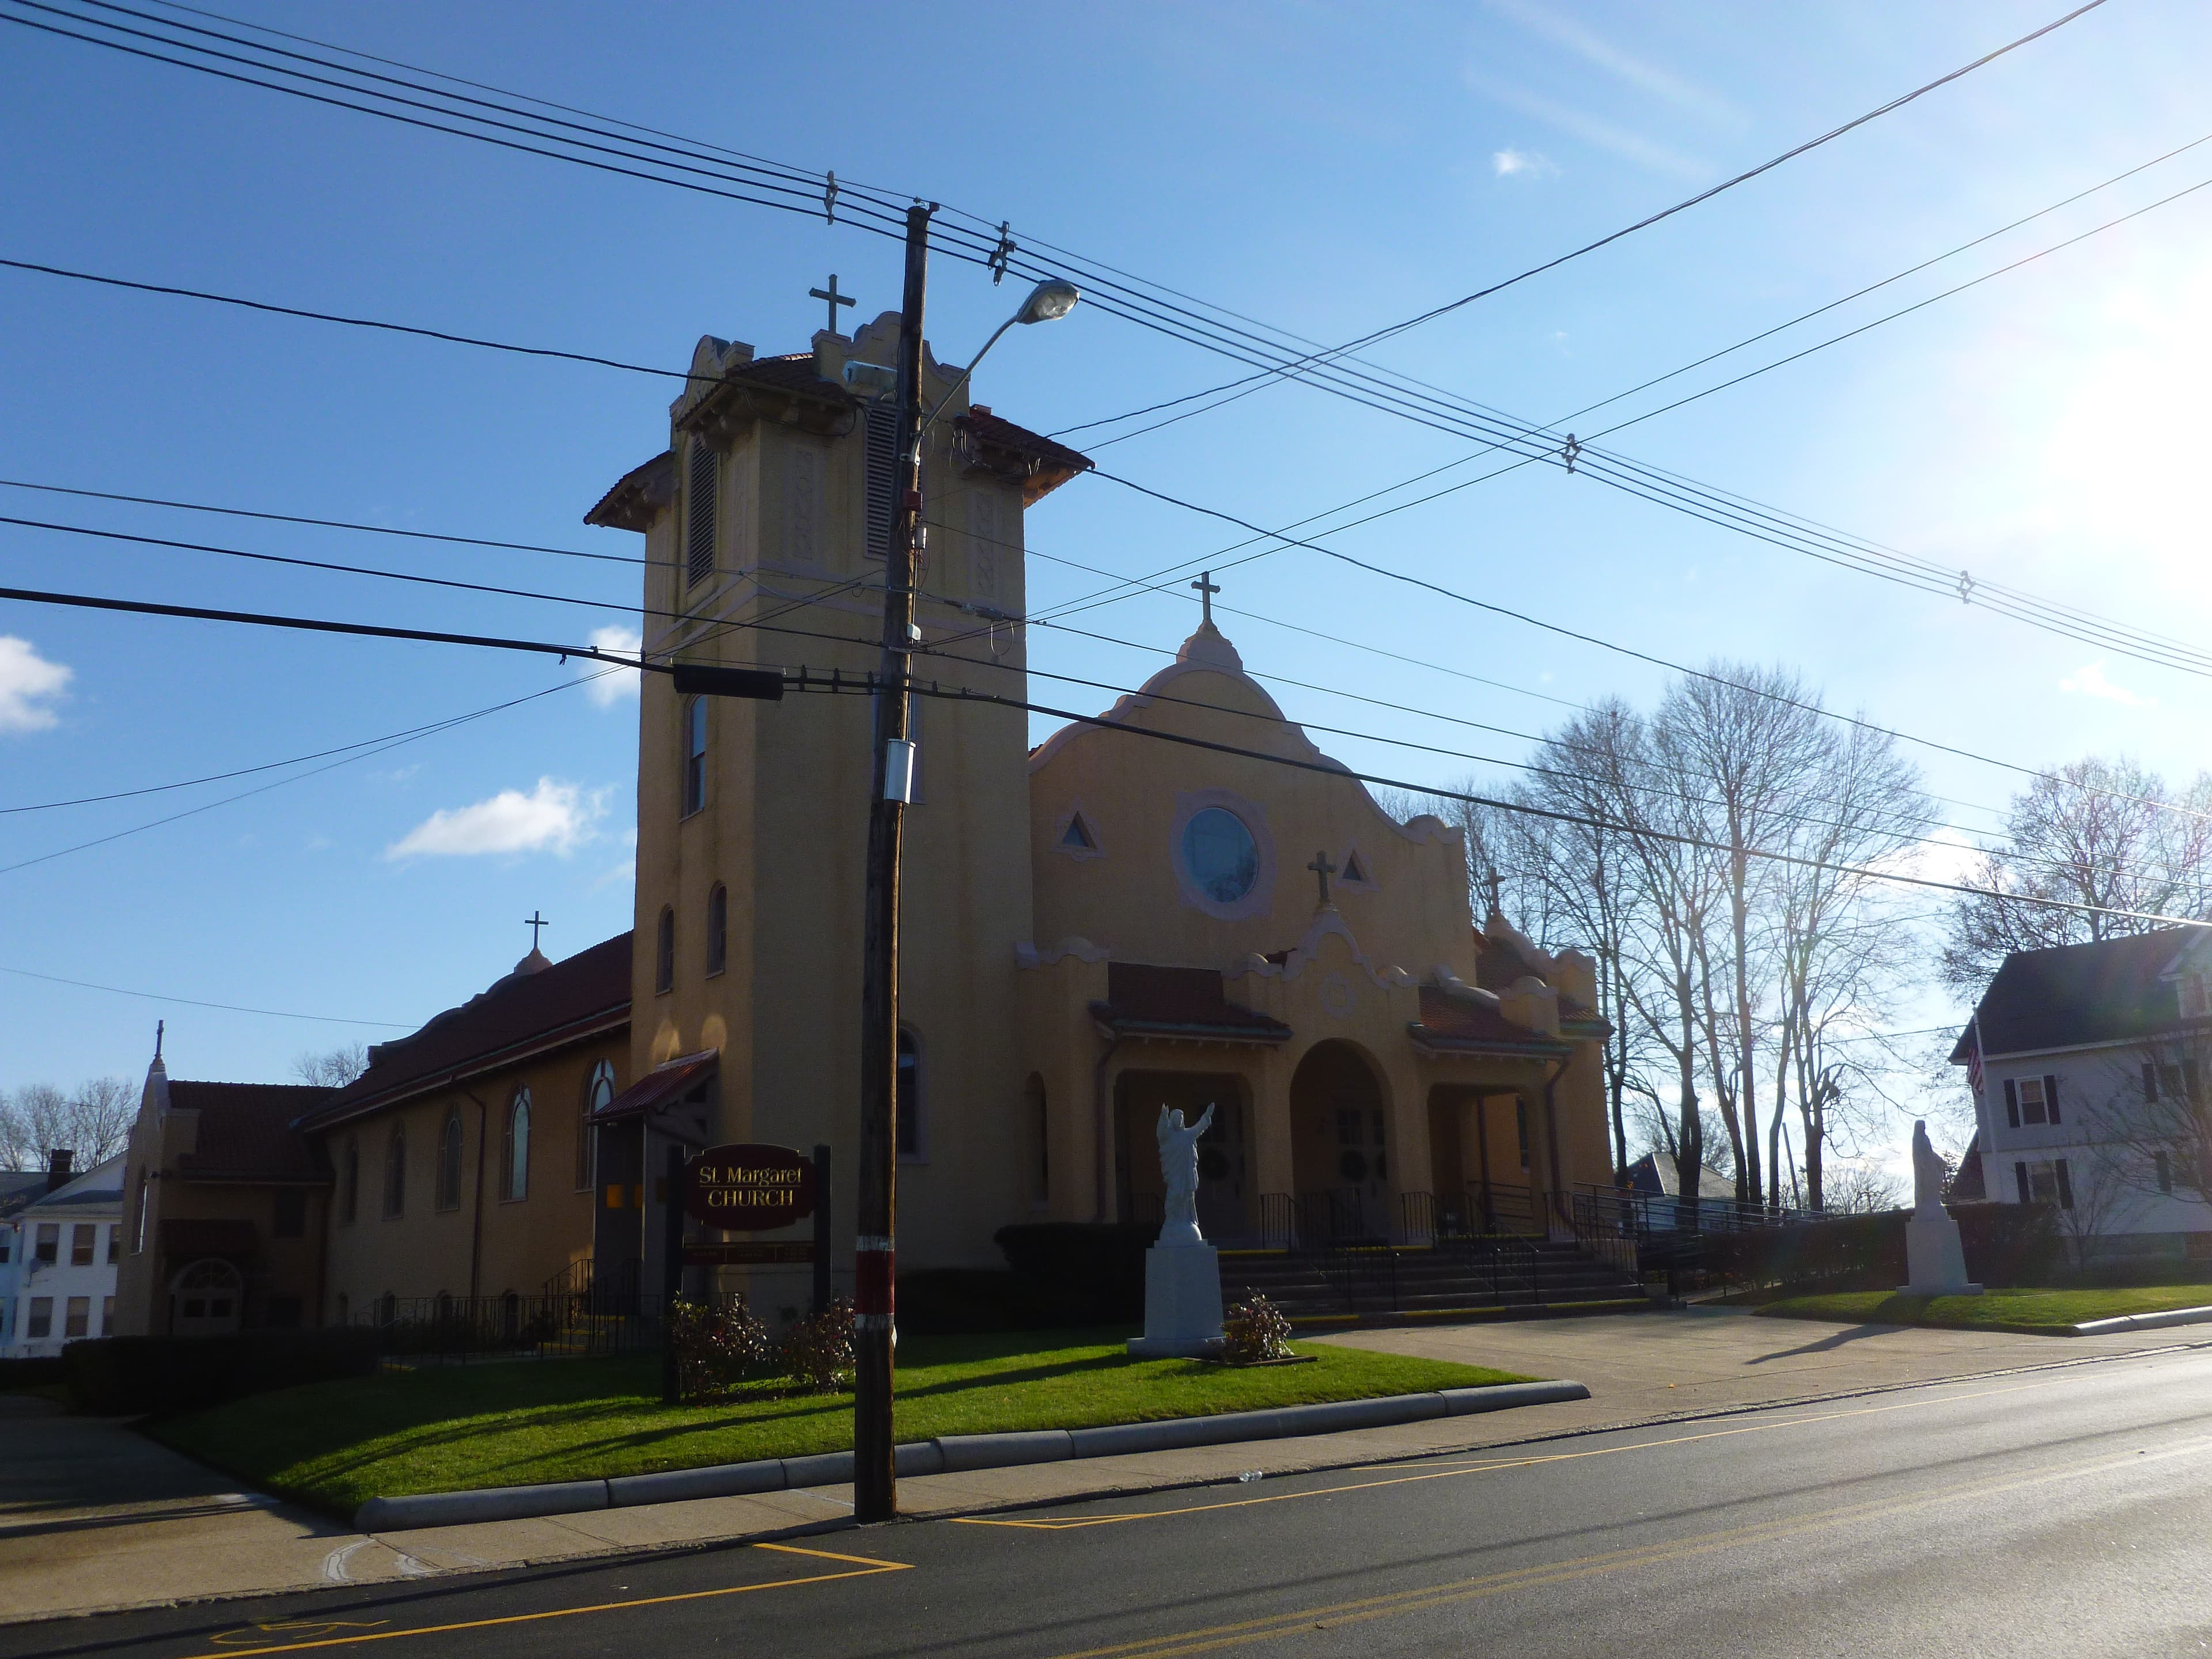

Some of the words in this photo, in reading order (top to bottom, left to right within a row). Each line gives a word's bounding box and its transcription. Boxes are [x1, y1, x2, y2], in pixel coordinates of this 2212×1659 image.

[699, 1166, 720, 1183] St.
[727, 1166, 802, 1187] Margaret
[707, 1189, 793, 1207] CHURCH
